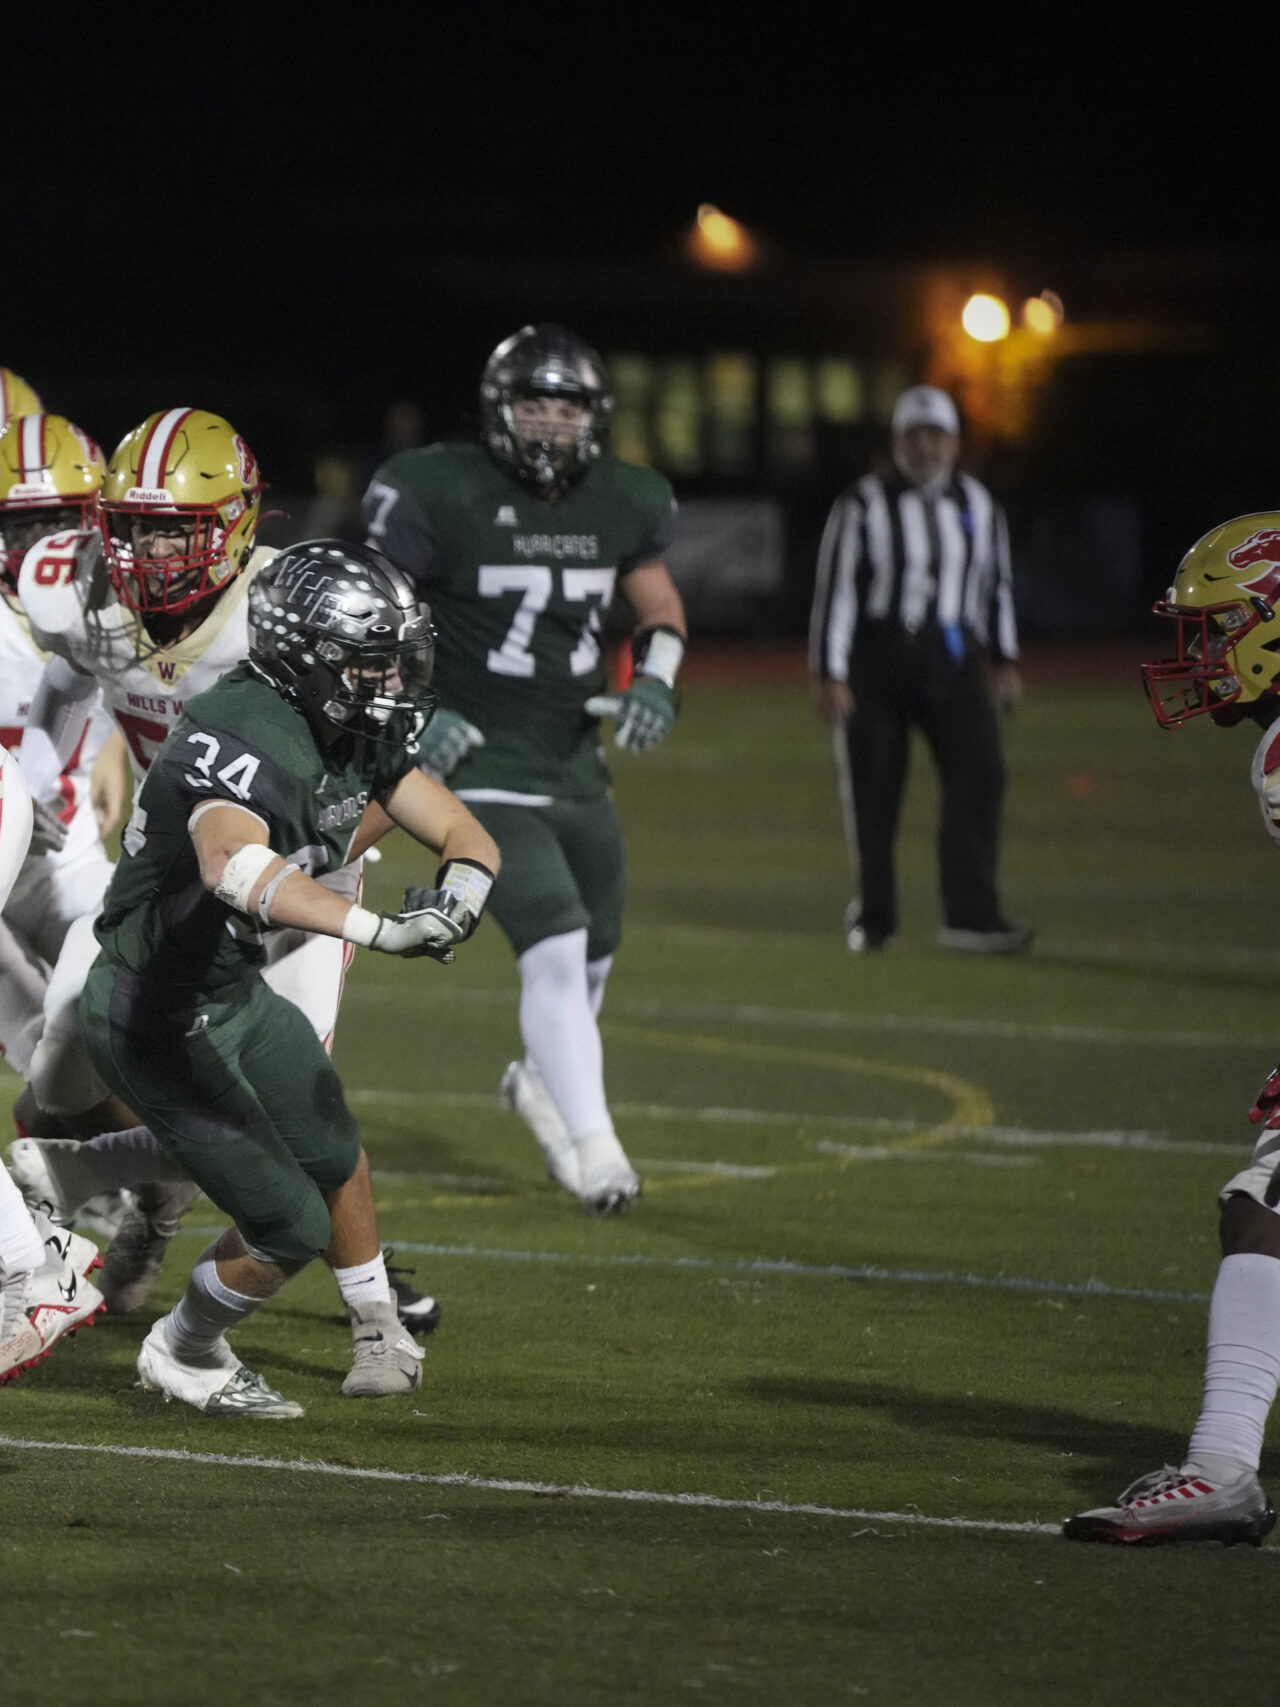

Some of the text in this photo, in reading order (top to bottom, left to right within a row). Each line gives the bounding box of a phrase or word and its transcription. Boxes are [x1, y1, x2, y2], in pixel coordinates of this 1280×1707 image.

[129, 490, 167, 502] Riddell
[477, 564, 618, 679] 77
[157, 661, 177, 680] W
[184, 731, 262, 801] 34
